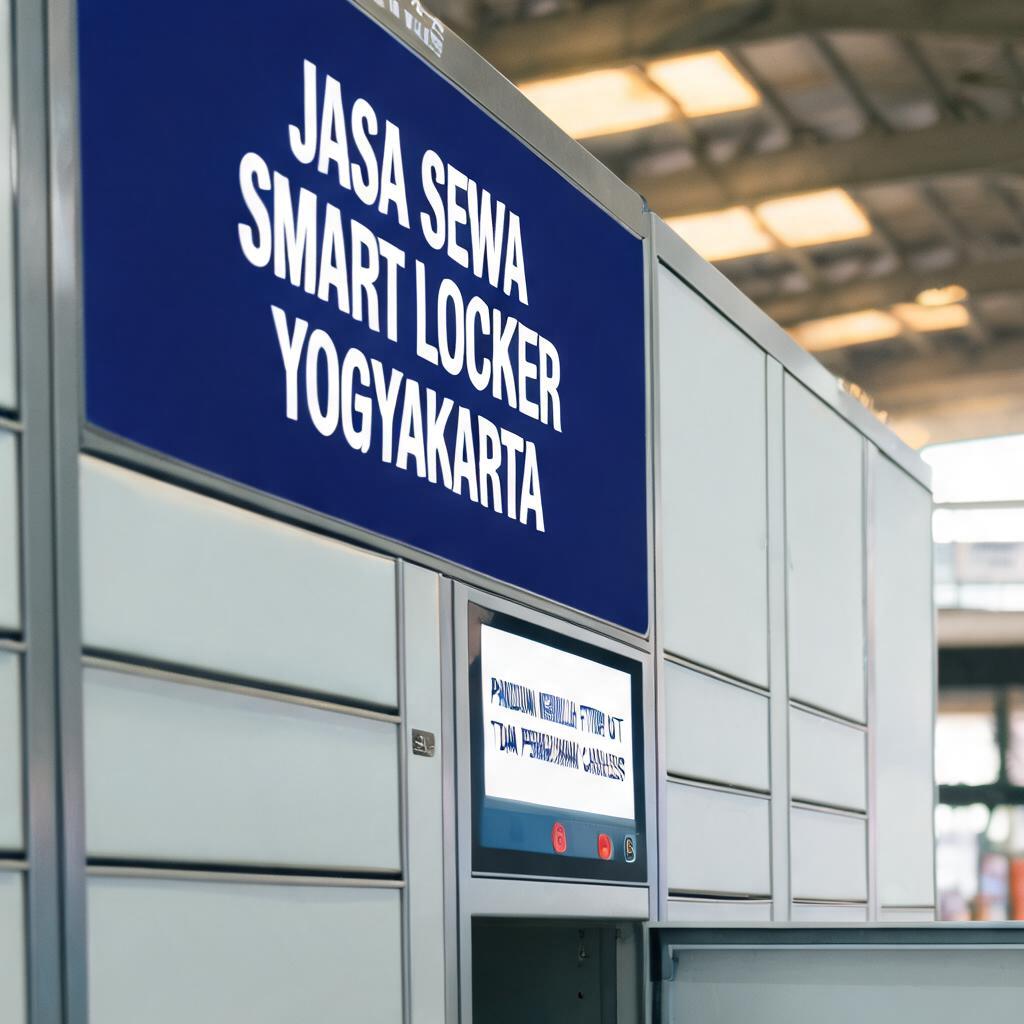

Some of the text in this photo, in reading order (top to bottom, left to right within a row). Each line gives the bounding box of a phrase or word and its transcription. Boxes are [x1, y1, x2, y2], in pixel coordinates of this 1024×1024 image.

[238, 152, 563, 433] SMART LOCKER
[289, 60, 529, 306] JASA SEWA
[271, 305, 546, 533] YOGYAKARTA
